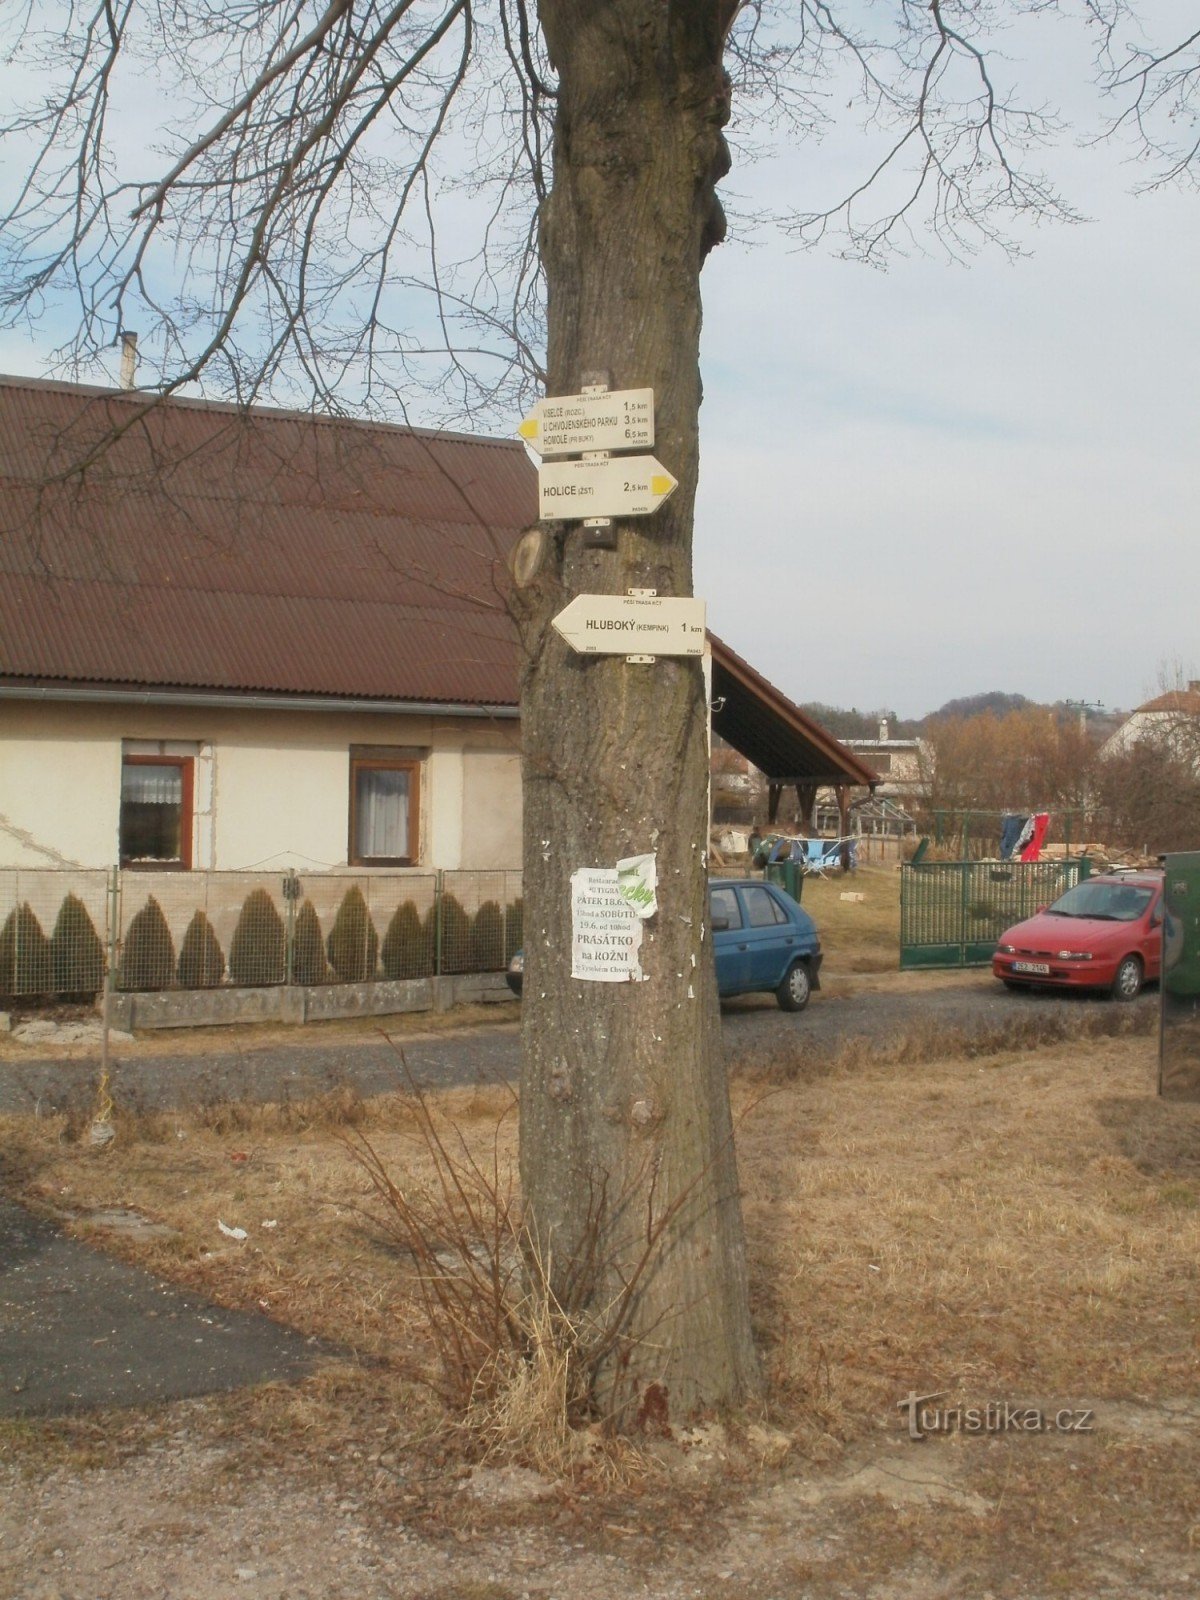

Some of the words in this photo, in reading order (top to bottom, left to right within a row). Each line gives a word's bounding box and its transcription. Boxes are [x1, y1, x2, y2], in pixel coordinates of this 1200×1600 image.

[624, 402, 636, 411] 1,5
[637, 402, 648, 410] km
[543, 422, 548, 432] U
[548, 418, 596, 431] CHVOJENSKÉHO
[597, 416, 618, 427] PARKU
[624, 416, 636, 425] 3,5
[625, 429, 636, 438] 6,5
[543, 434, 568, 445] HOMOLE
[543, 486, 577, 497] HOLICE
[624, 482, 636, 492] 2,5
[586, 618, 635, 630] HLUBOKÝ
[636, 624, 669, 633] (KEMPINK)
[681, 622, 687, 632] 1
[582, 952, 592, 960] na
[594, 950, 629, 962] ROŽNI
